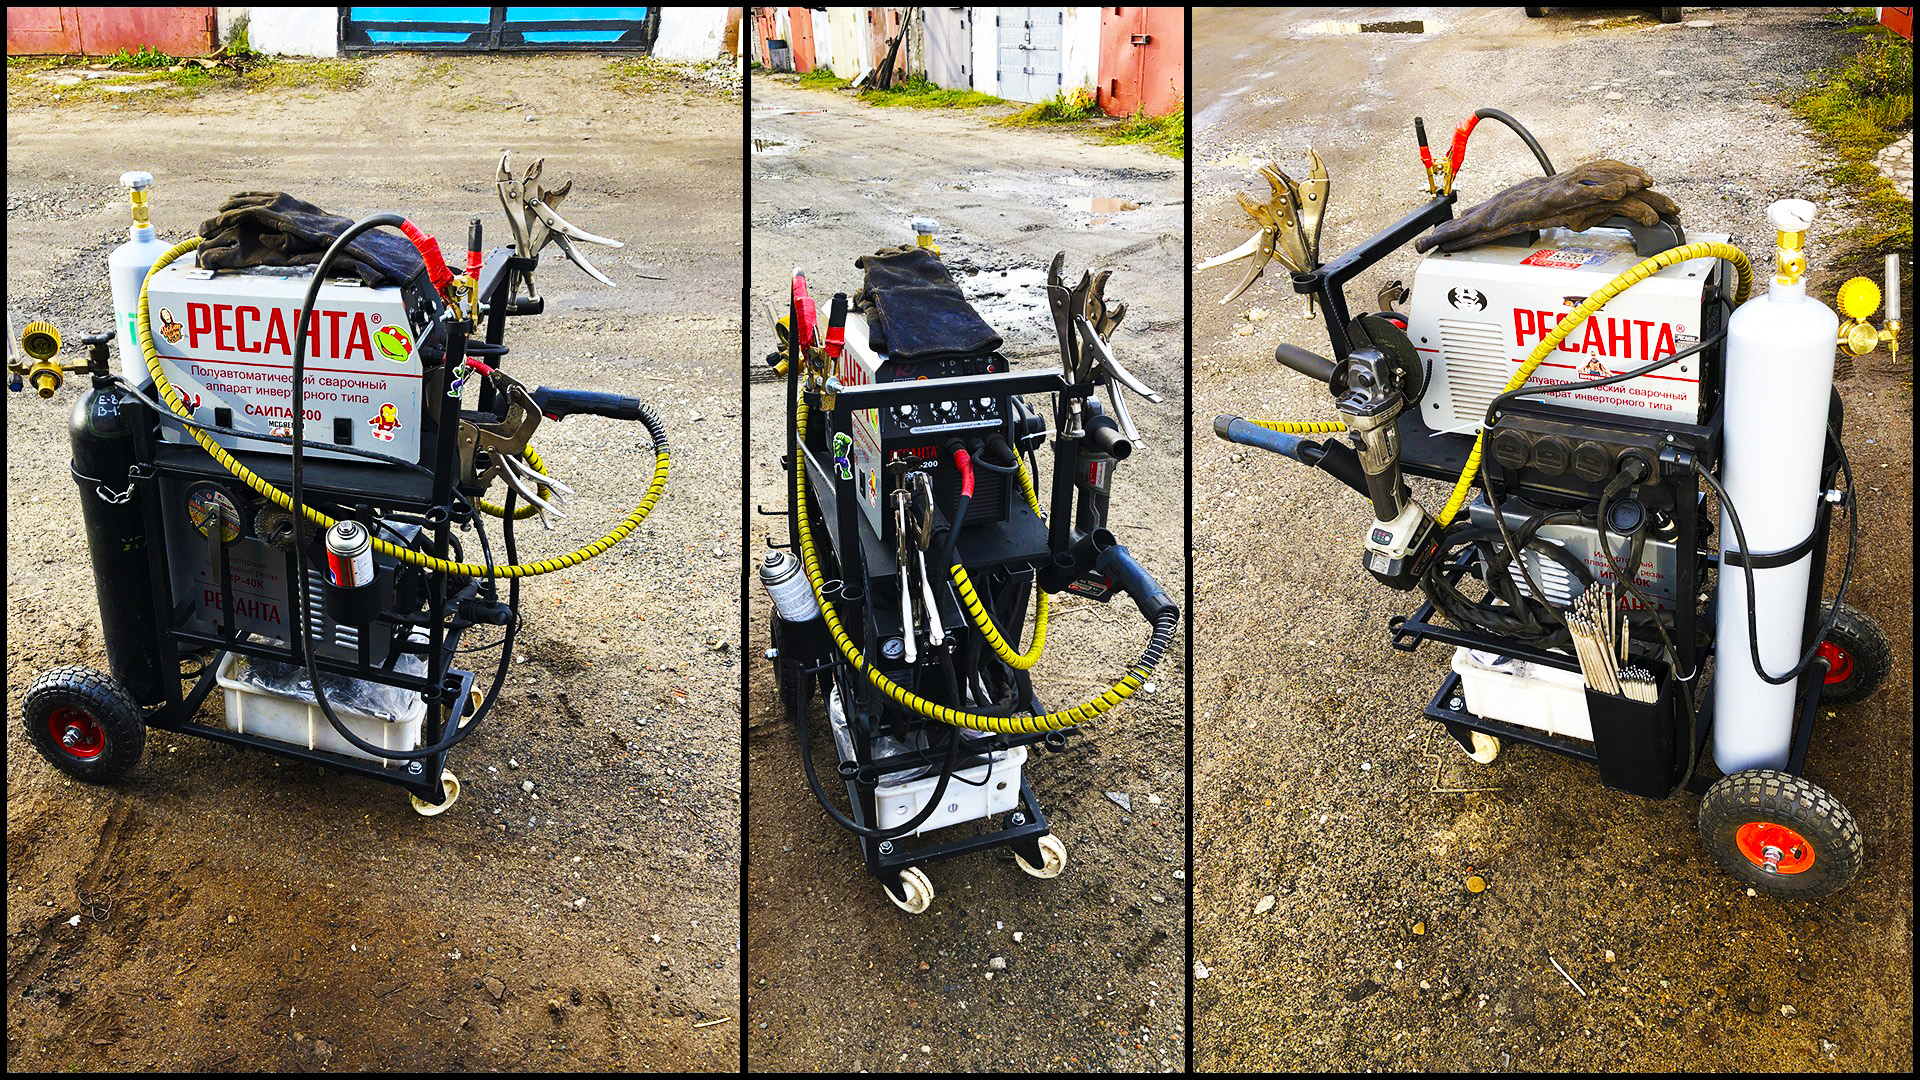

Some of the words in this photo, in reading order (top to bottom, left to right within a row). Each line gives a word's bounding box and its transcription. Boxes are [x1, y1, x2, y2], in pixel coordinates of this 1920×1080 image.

[187, 302, 374, 361] РЕСАНТА
[1513, 307, 1678, 363] РЕСАНТА
[191, 365, 315, 384] Полуавтоматичесий
[318, 377, 387, 391] сварочный
[205, 382, 252, 395] аппарат
[256, 387, 338, 402] инверрного
[341, 393, 370, 404] типа
[1574, 393, 1645, 408] инверторного
[1648, 402, 1673, 411] типа
[1629, 387, 1687, 401] сварочный
[245, 403, 294, 419] САИПА
[204, 589, 281, 624] РЕАНТА
